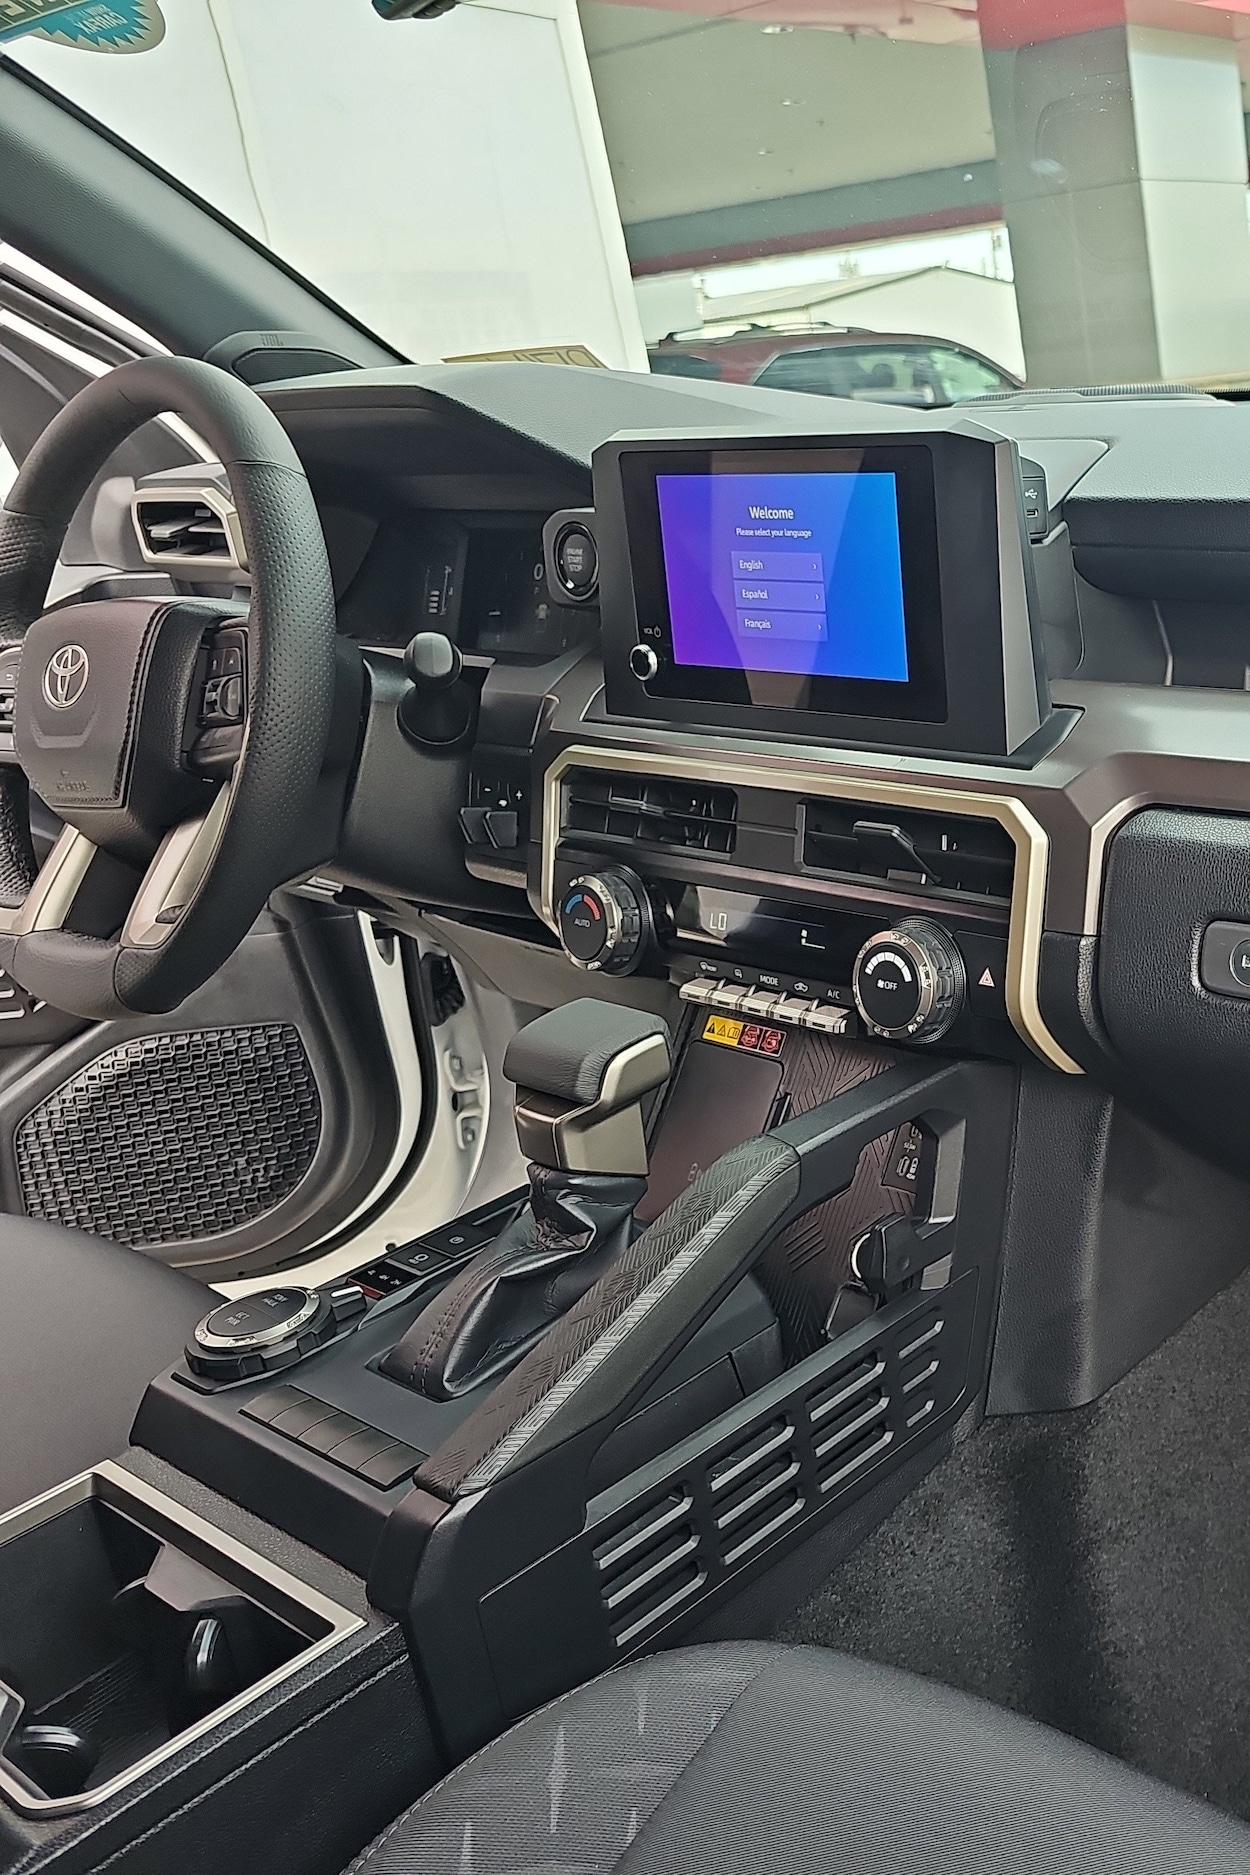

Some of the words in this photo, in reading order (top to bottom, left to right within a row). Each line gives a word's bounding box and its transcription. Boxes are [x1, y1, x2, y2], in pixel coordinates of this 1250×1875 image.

[748, 506, 794, 519] Welcome
[736, 527, 754, 536] Please
[755, 528, 771, 536] select
[771, 529, 783, 539] your
[784, 528, 812, 539] language
[569, 564, 583, 572] STOP
[739, 560, 764, 571] English
[742, 589, 768, 600] Español
[744, 618, 771, 630] Français
[573, 917, 591, 928] AUTO
[760, 974, 779, 986] MODE
[884, 982, 898, 991] OFF
[827, 989, 840, 1000] A/C
